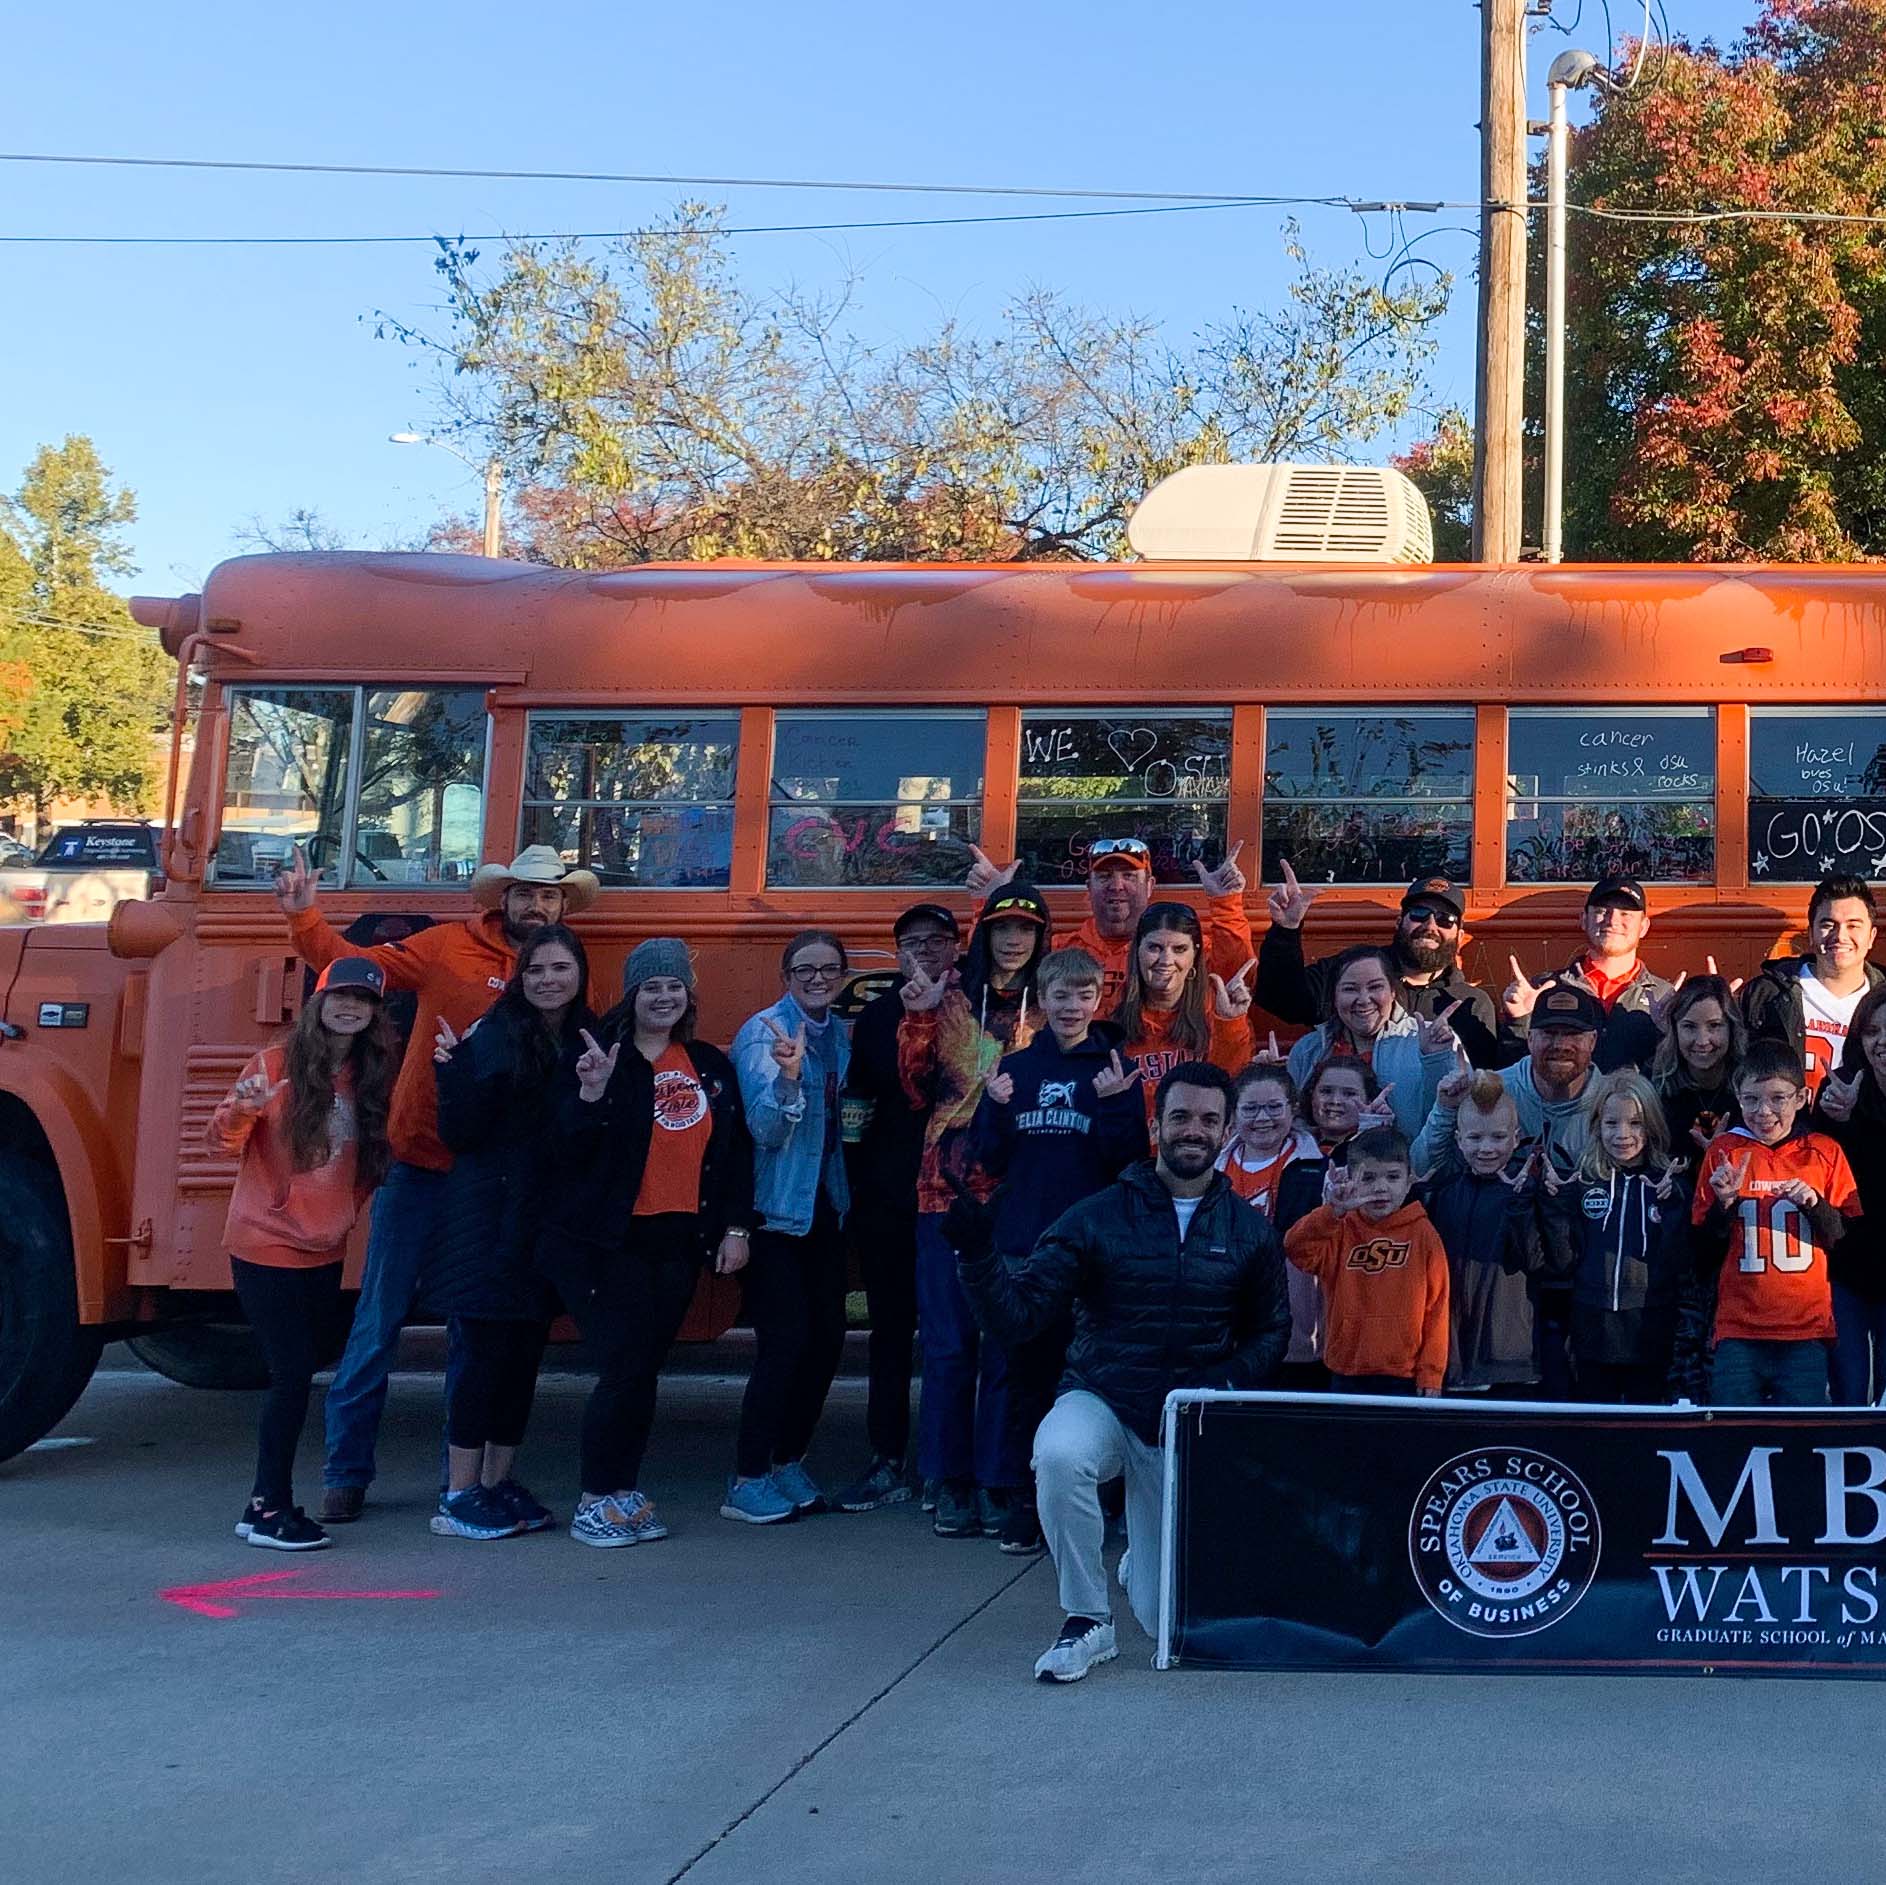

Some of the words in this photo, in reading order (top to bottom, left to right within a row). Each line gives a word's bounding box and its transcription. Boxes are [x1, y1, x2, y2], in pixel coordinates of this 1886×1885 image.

[1026, 728, 1078, 762] WE
[1580, 730, 1654, 748] cancer
[1796, 742, 1853, 765] Hazel
[1578, 760, 1628, 777] stinks
[1657, 773, 1699, 788] rocks
[85, 836, 136, 848] Keystone
[1046, 1109, 1092, 1134] CLINTON
[1737, 1198, 1813, 1272] 10
[1346, 1238, 1411, 1274] OSU
[1420, 1458, 1491, 1552] SPEARS
[1506, 1456, 1590, 1552] SCHOOL
[1450, 1493, 1480, 1578] OKLAHOMA
[1484, 1482, 1528, 1495] STATE
[1533, 1493, 1564, 1579] UNIVERSITY
[1439, 1579, 1464, 1602] OF
[1468, 1579, 1571, 1623] BUSINESS
[1656, 1628, 1752, 1644] GRADUATE
[1760, 1630, 1830, 1645] SCHOOL
[1837, 1631, 1856, 1648] of
